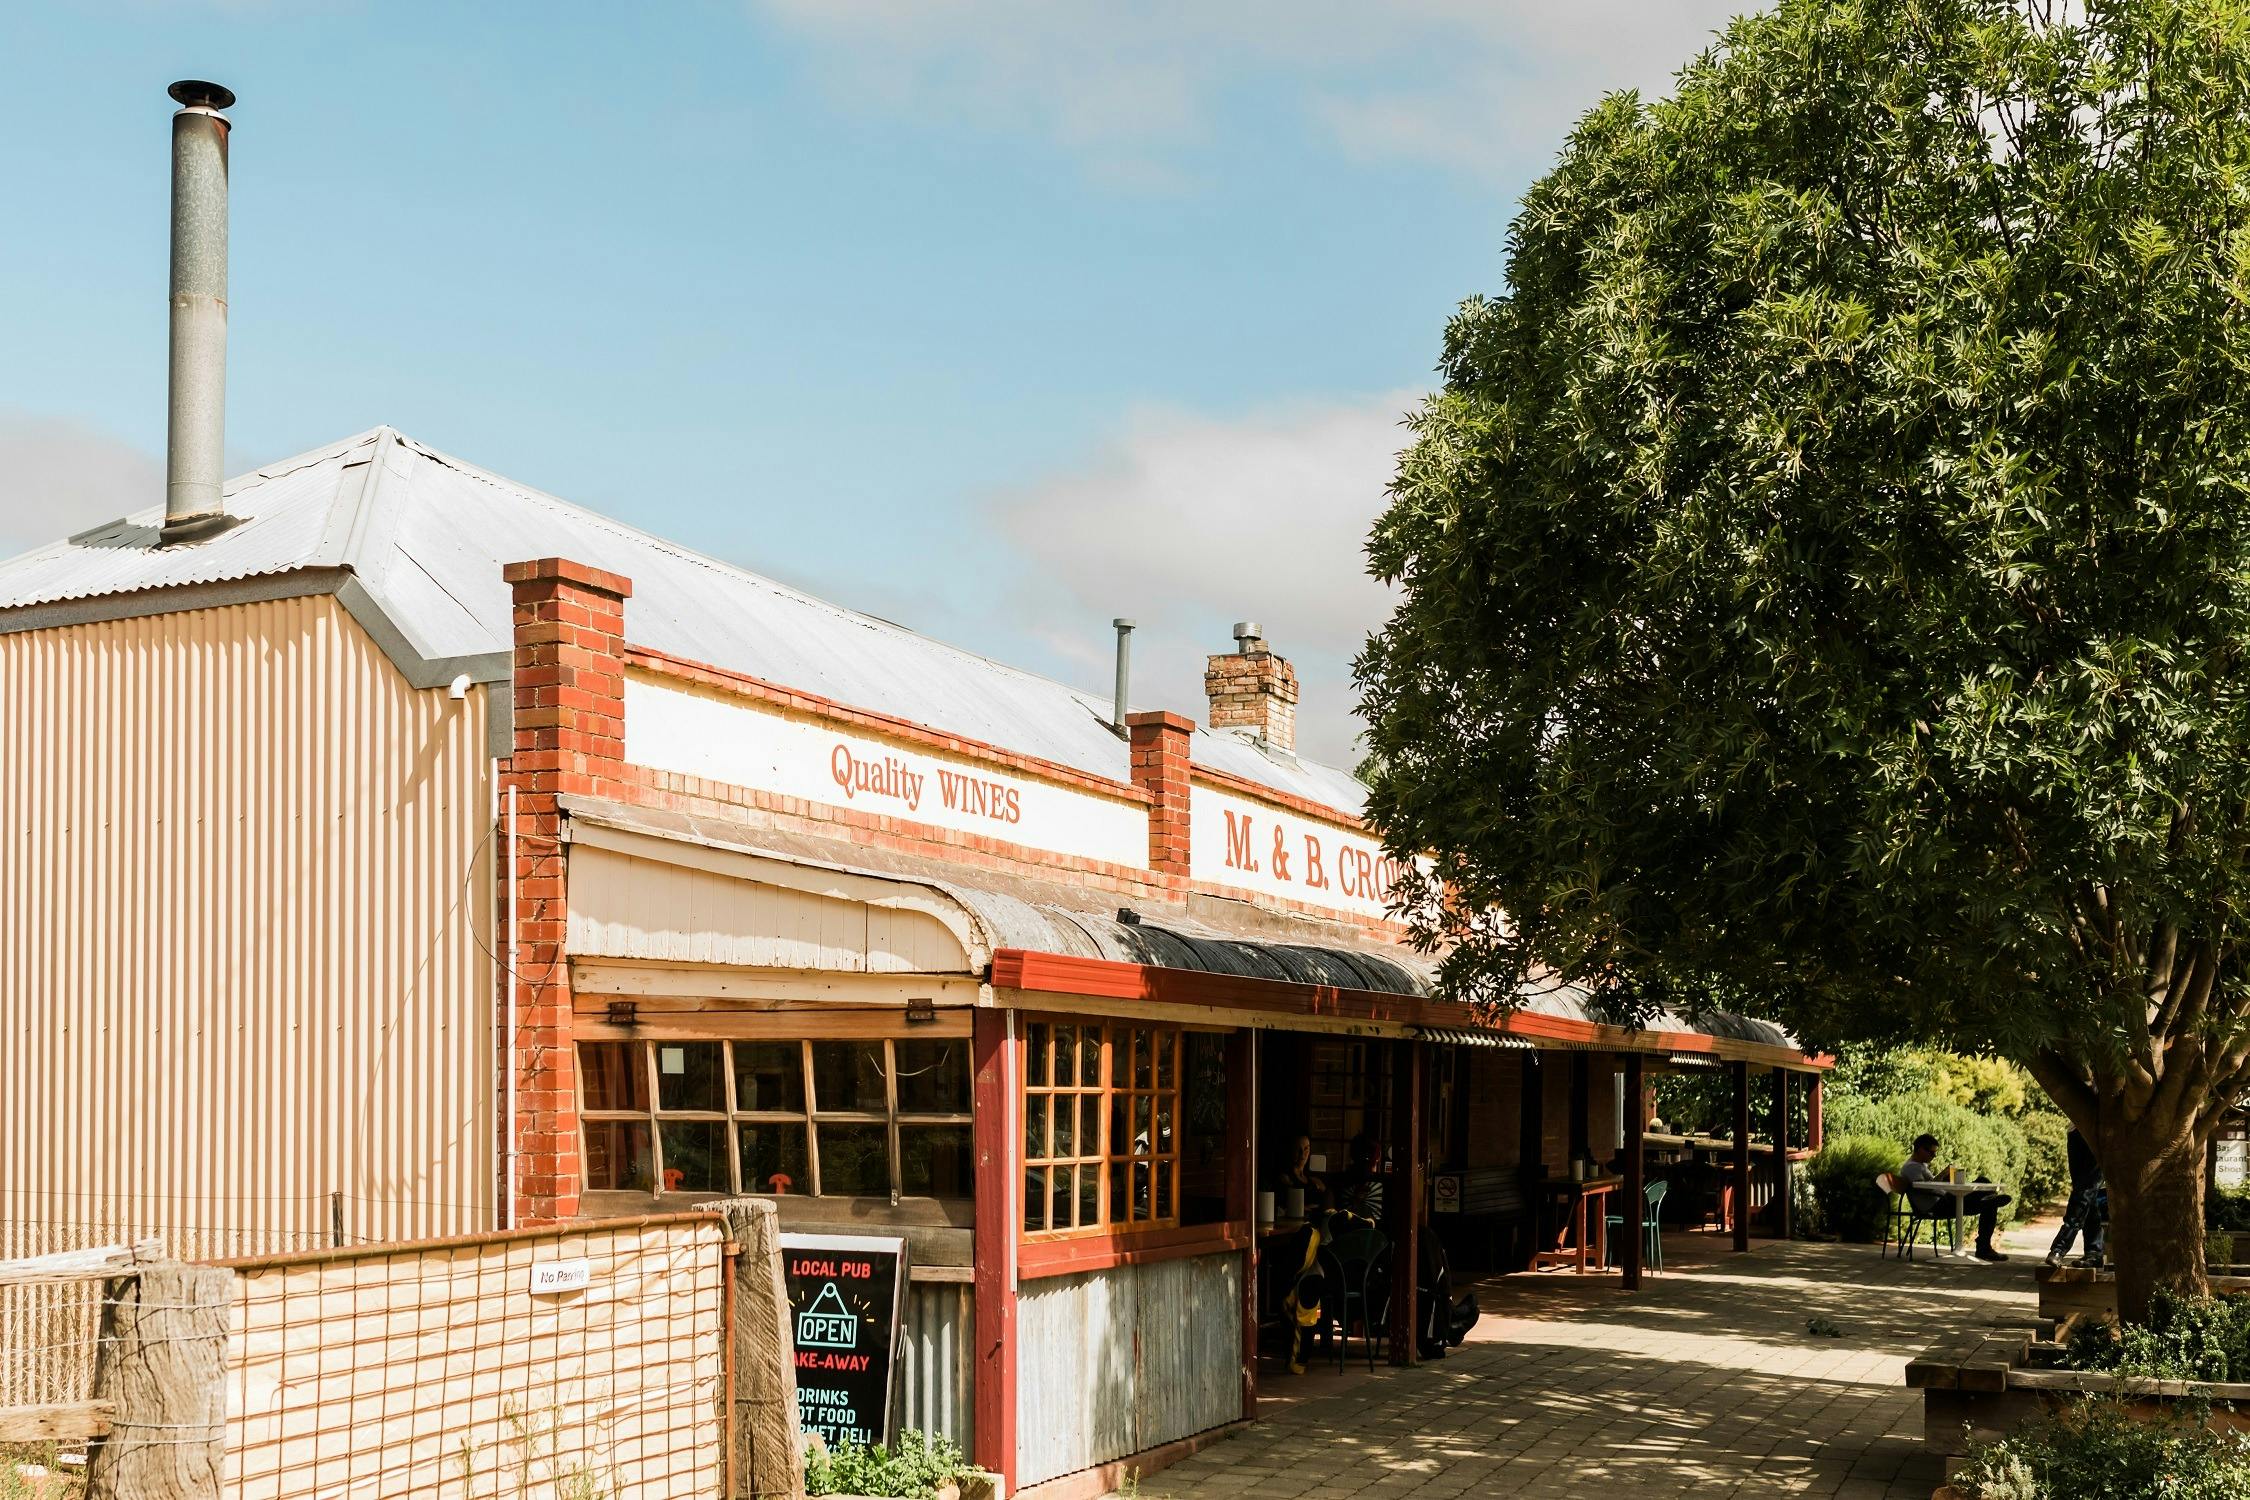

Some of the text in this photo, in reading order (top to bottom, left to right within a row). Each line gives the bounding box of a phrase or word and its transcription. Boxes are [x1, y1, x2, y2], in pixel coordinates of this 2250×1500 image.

[831, 744, 1021, 824] Quality WINES
[1224, 810, 1259, 873] M.
[1272, 824, 1292, 881] &
[1304, 834, 1329, 890] B.
[540, 1271, 554, 1283] No
[792, 1260, 871, 1278] LOCAL PUB
[802, 1318, 852, 1342] OPEN
[793, 1352, 870, 1371] AKE-AWAY
[797, 1388, 849, 1405] DRINKS
[799, 1406, 856, 1424] OT FOOD
[840, 1427, 872, 1444] DELI
